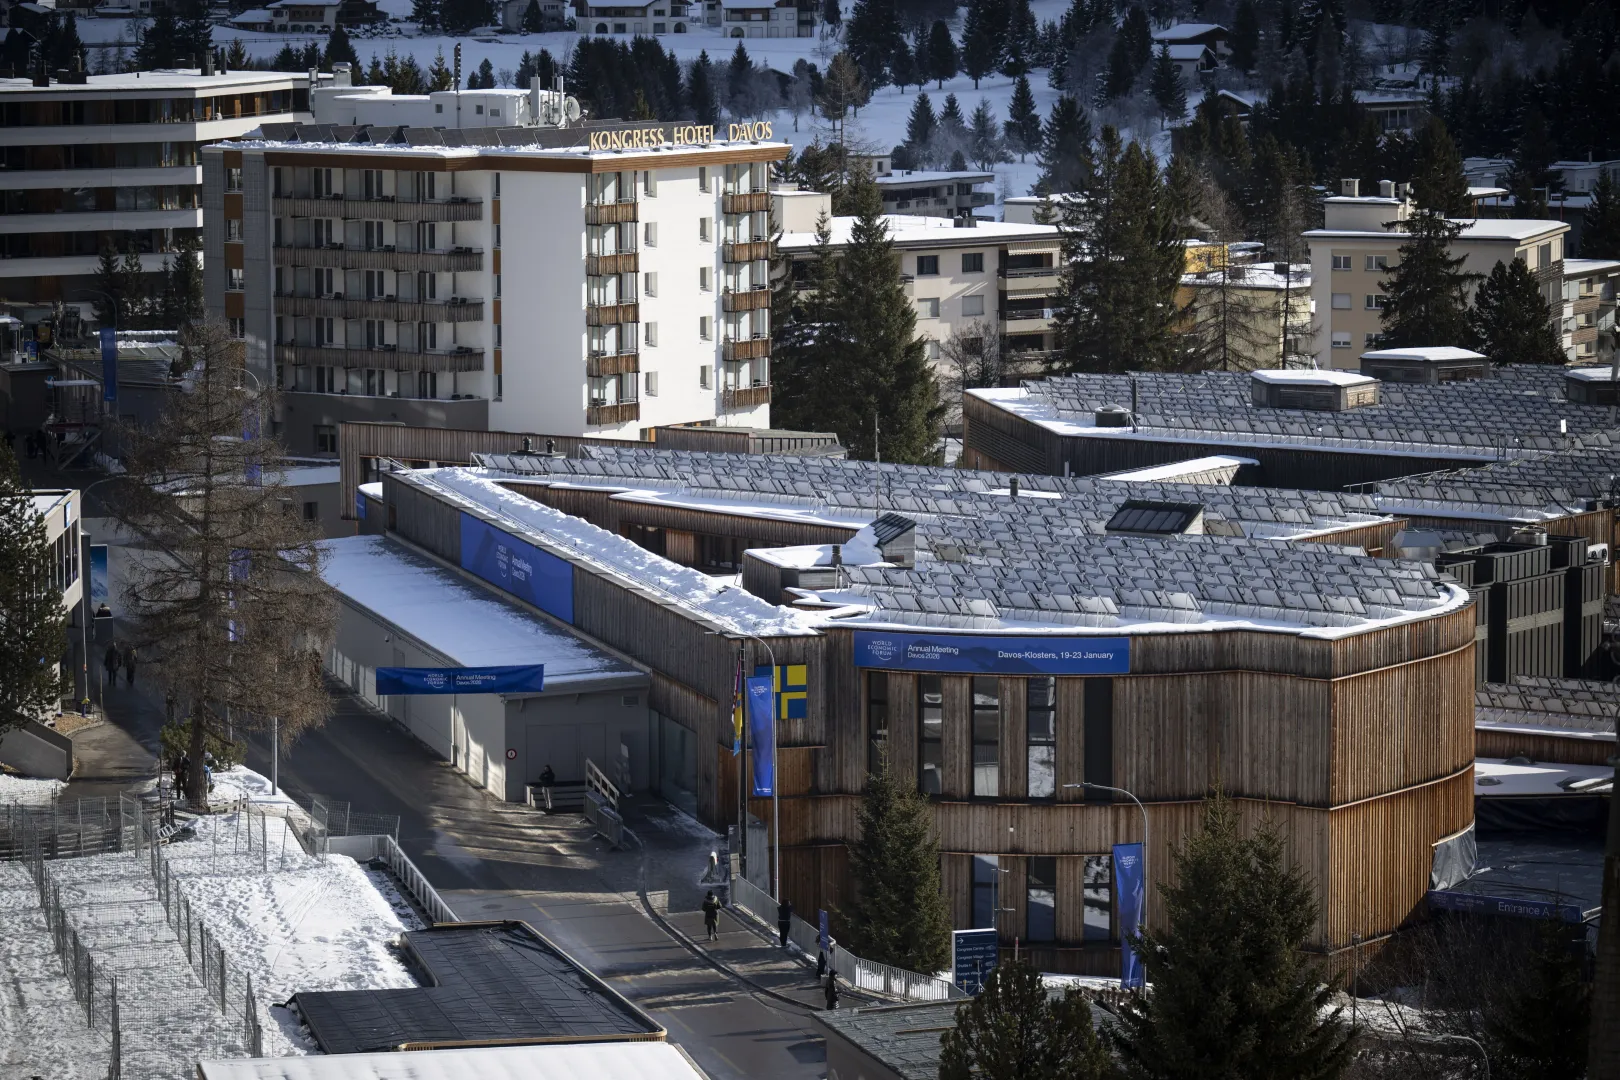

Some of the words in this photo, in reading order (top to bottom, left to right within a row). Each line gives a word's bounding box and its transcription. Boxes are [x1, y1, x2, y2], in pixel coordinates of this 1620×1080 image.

[590, 128, 664, 150] KONGRESS
[673, 125, 716, 145] HOTEL
[729, 121, 772, 141] DAVOS
[907, 644, 931, 653] Annual
[931, 645, 959, 655] Meeting
[997, 650, 1058, 660] Davos-Klosters,
[1060, 651, 1082, 659] 19-23
[1083, 651, 1114, 660] January
[907, 651, 925, 659] Davos
[925, 652, 940, 660] 2026
[1498, 901, 1541, 916] Entrance
[1542, 906, 1550, 917] A
